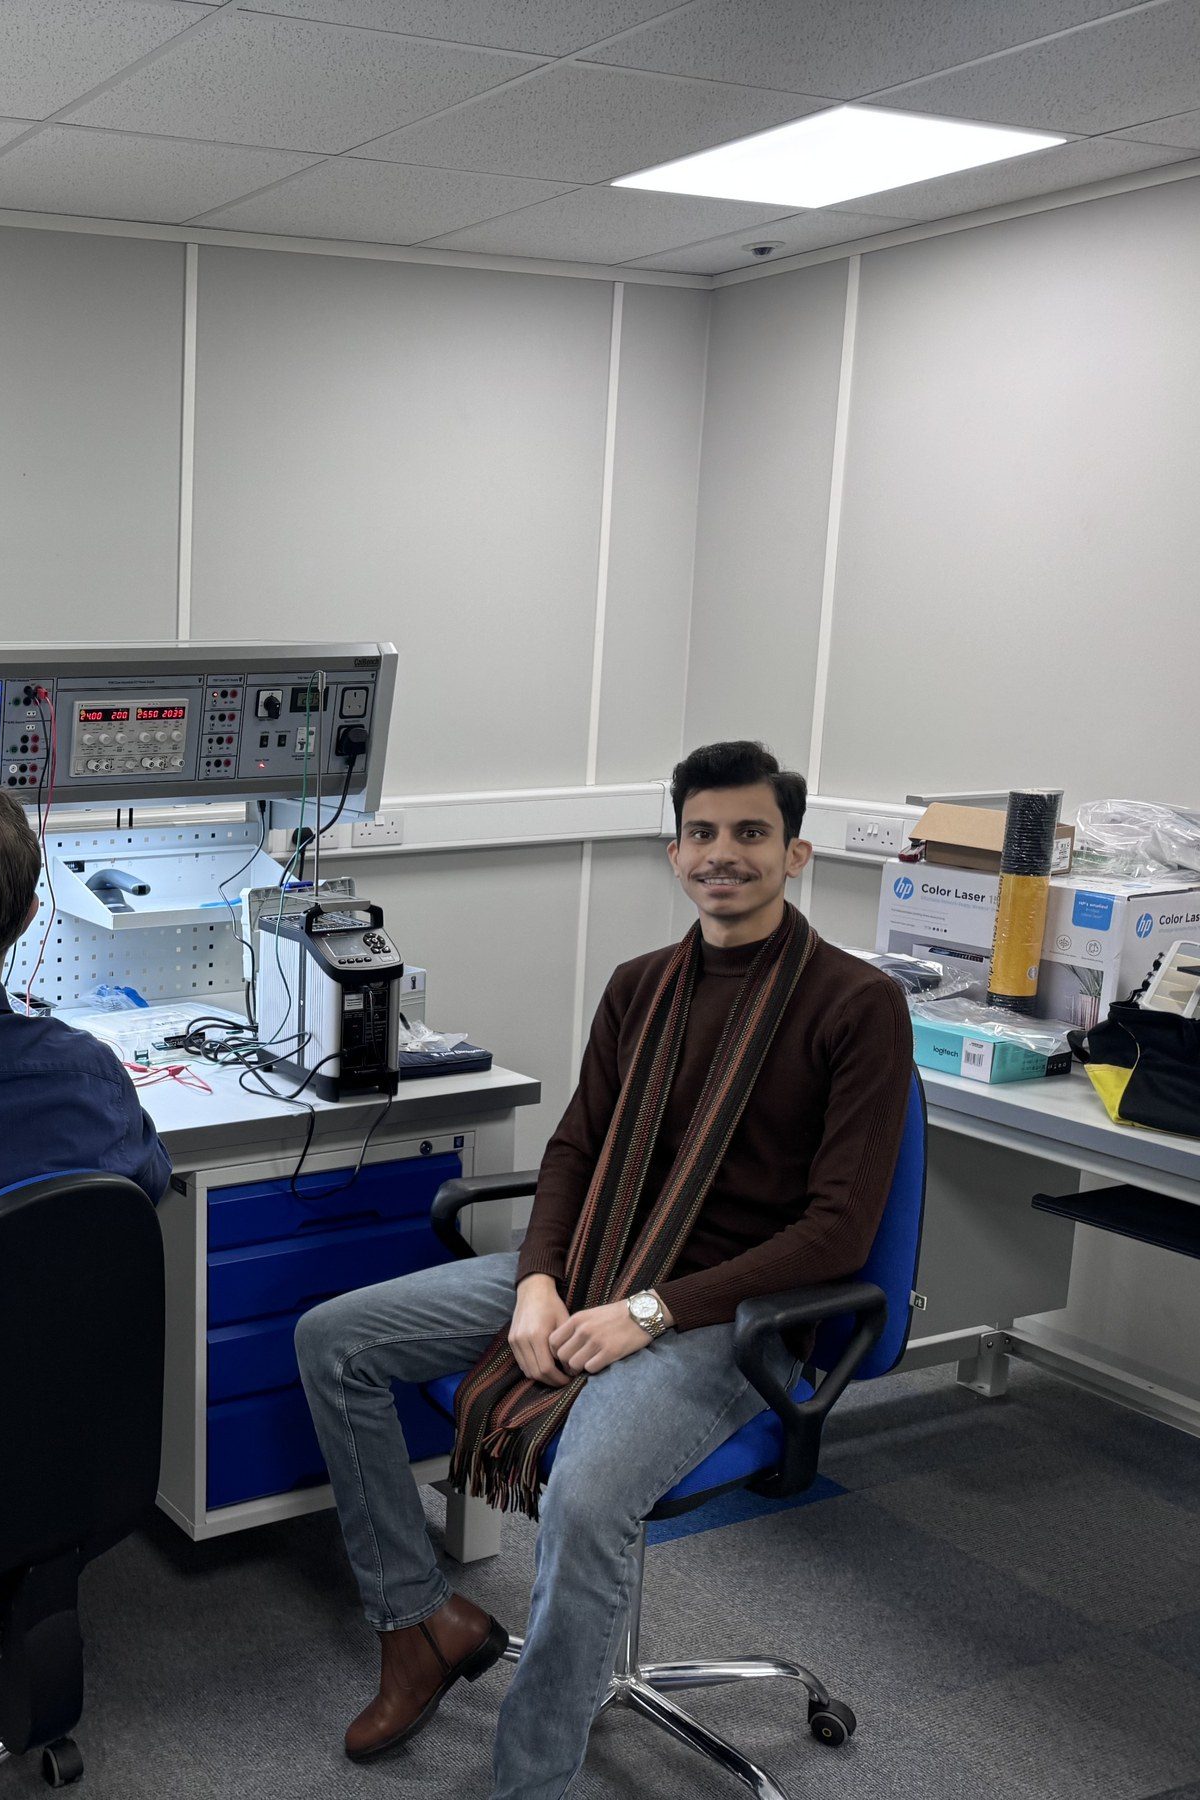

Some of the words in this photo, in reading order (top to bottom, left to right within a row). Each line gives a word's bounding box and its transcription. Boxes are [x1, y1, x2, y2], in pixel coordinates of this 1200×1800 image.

[894, 876, 914, 901] hp
[921, 883, 951, 897] Color
[954, 889, 986, 903] Laser
[1136, 913, 1154, 939] hp
[1159, 914, 1183, 925] Color
[933, 1045, 959, 1058] logitech
